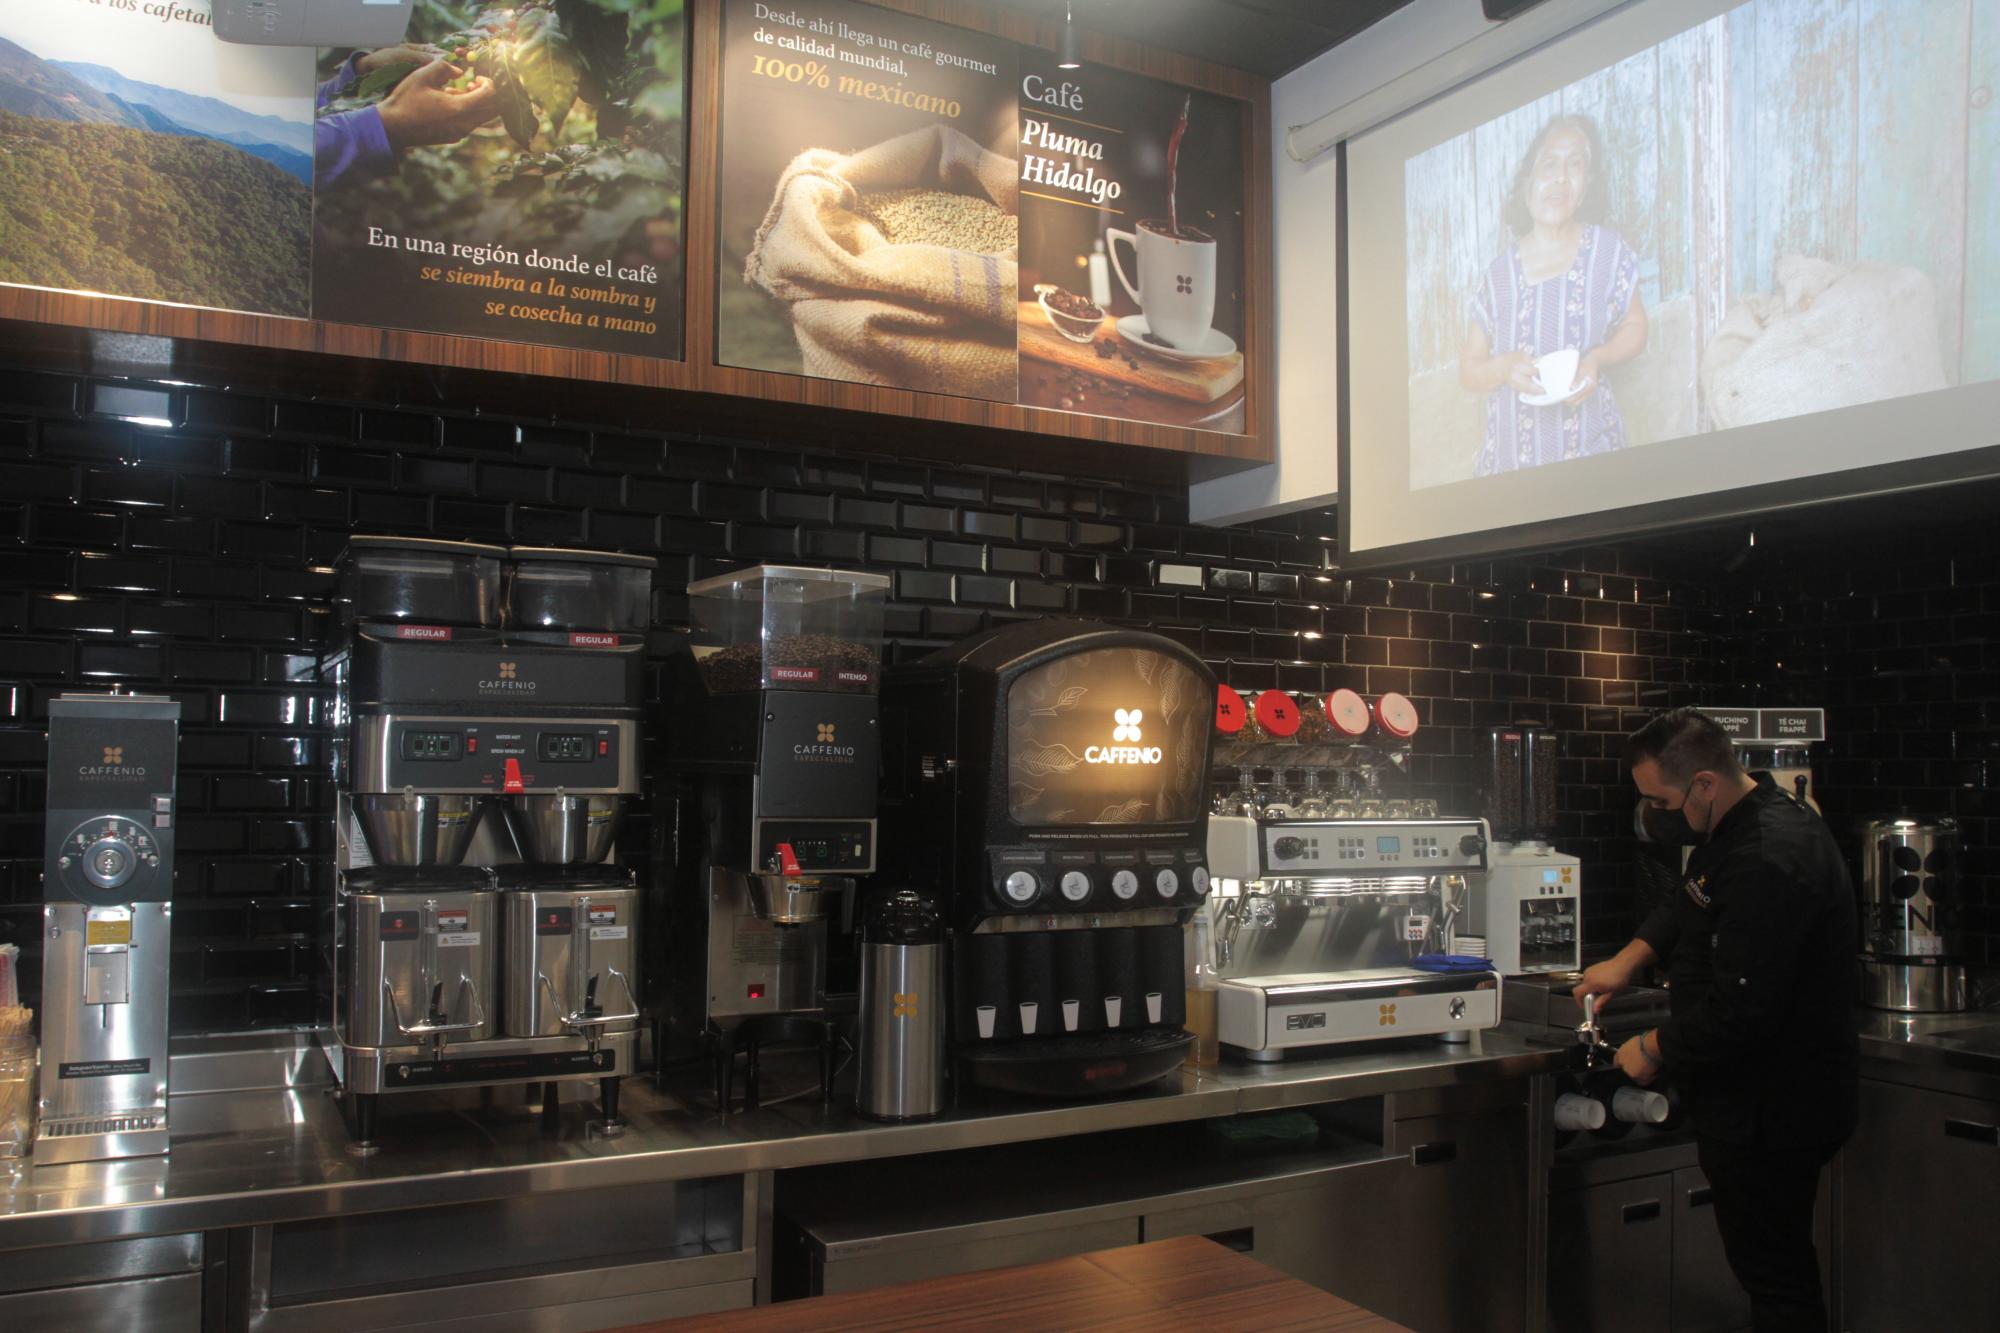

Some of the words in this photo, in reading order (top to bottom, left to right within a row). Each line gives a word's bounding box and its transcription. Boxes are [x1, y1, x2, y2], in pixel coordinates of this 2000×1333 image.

[753, 27, 774, 45] de
[778, 35, 836, 59] calidad
[839, 49, 908, 78] mundial,
[755, 3, 805, 28] Desde
[809, 18, 834, 36] ahí
[838, 22, 874, 47] llega
[878, 36, 898, 51] un
[902, 43, 933, 59] café
[935, 51, 998, 75] gourmet
[751, 55, 830, 89] 100%
[838, 75, 961, 118] mexicano
[1022, 75, 1084, 111] Café
[1021, 118, 1104, 161] Pluma
[1021, 154, 1121, 204] Hidalgo
[367, 226, 399, 249] En
[404, 237, 447, 256] una
[453, 243, 520, 266] región
[525, 249, 591, 275] donde
[595, 259, 613, 279] el
[618, 264, 658, 284] café
[420, 266, 442, 281] se
[446, 267, 526, 293] siembra
[530, 280, 543, 295] a
[547, 277, 566, 298] la
[570, 286, 640, 308] sombra
[644, 296, 657, 315] y
[485, 301, 506, 316] se
[509, 305, 583, 326] cosecha
[587, 313, 600, 328] a
[604, 315, 657, 335] mano
[404, 628, 446, 639] REGULAR
[575, 636, 614, 645] REGULAR
[478, 680, 537, 690] CAFFENIO
[777, 670, 814, 679] REGULAR
[838, 672, 868, 681] INTENSO
[1788, 718, 1807, 726] CHAI
[793, 744, 855, 756] CAFFENIO
[1084, 745, 1163, 765] CAFFENIO
[79, 766, 146, 776] CAFFENIO
